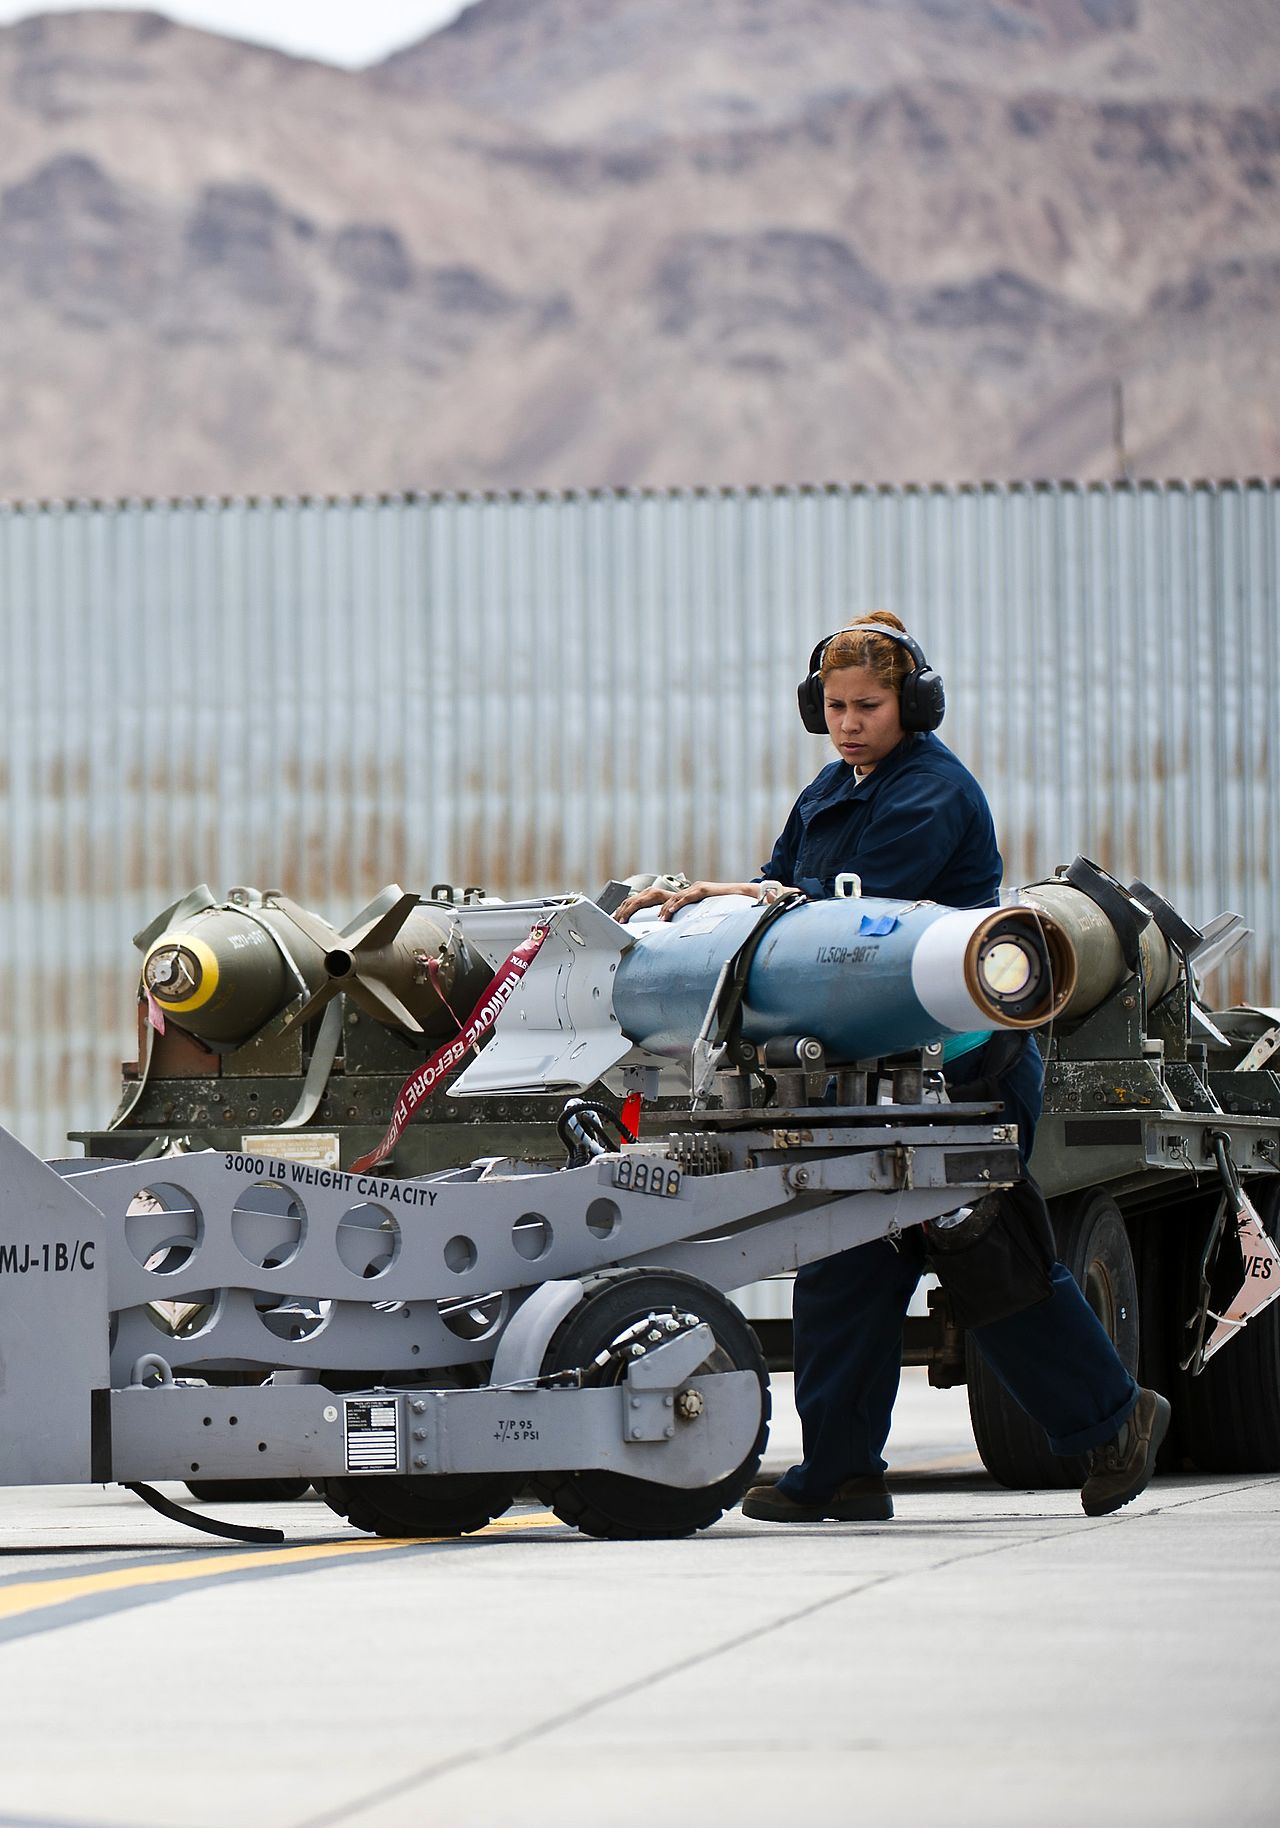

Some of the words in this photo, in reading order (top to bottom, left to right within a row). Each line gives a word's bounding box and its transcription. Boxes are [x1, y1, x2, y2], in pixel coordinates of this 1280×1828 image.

[406, 1041, 465, 1108] BEFORE
[374, 1100, 408, 1161] FLIGHT
[225, 1154, 264, 1175] 3000
[269, 1161, 286, 1180] LB
[292, 1164, 353, 1192] WEIGHT
[357, 1178, 438, 1207] CAPACITY
[498, 1420, 516, 1430] T/P
[519, 1420, 532, 1430] 95
[514, 1431, 520, 1440] 5
[523, 1431, 539, 1440] PSI
